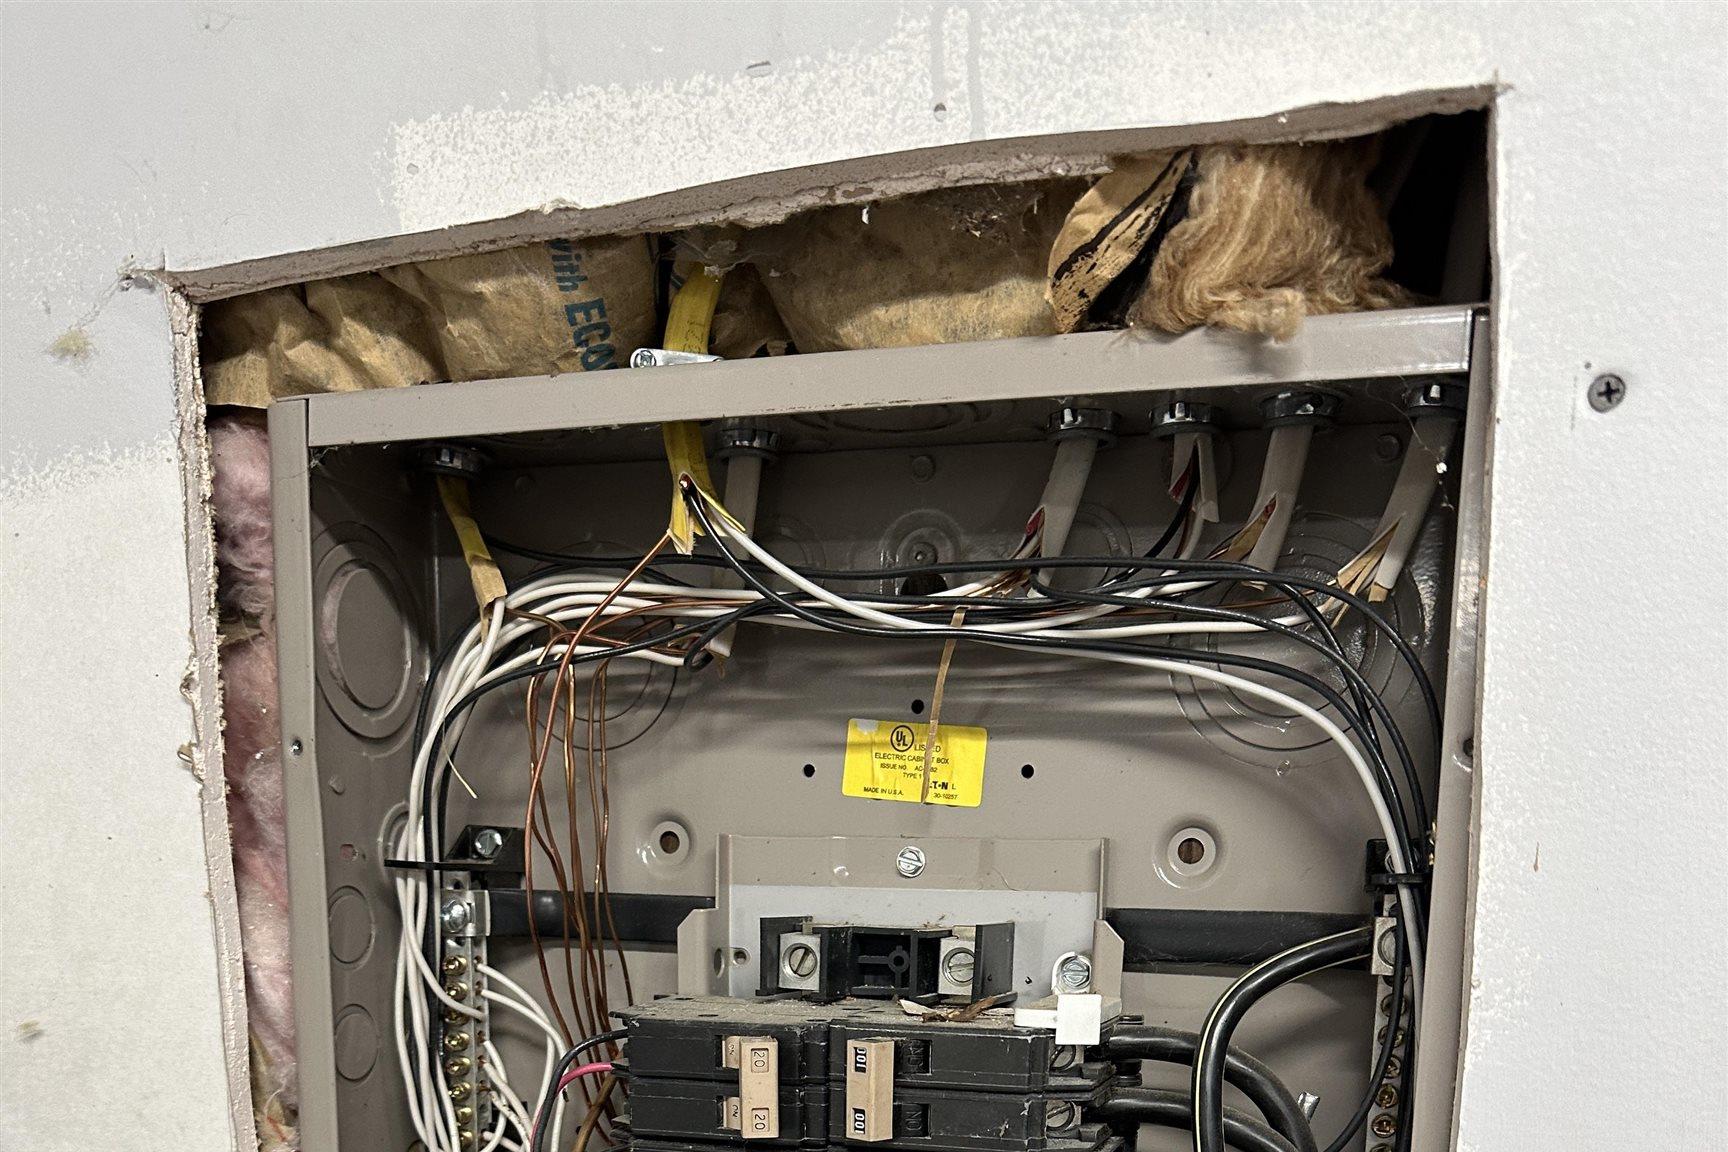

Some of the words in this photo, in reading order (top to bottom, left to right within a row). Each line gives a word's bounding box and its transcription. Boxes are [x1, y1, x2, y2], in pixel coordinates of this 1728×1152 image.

[564, 297, 619, 371] ECO
[914, 743, 941, 753] LISD
[875, 752, 906, 761] ELECTRIC
[936, 757, 949, 765] BOX
[880, 762, 897, 770] ISSUE
[863, 786, 879, 794] MADE
[754, 1051, 766, 1068] 20
[856, 1047, 867, 1068] 100
[754, 1113, 766, 1130] 20
[855, 1112, 865, 1135] 100
[905, 1110, 923, 1132] ON
